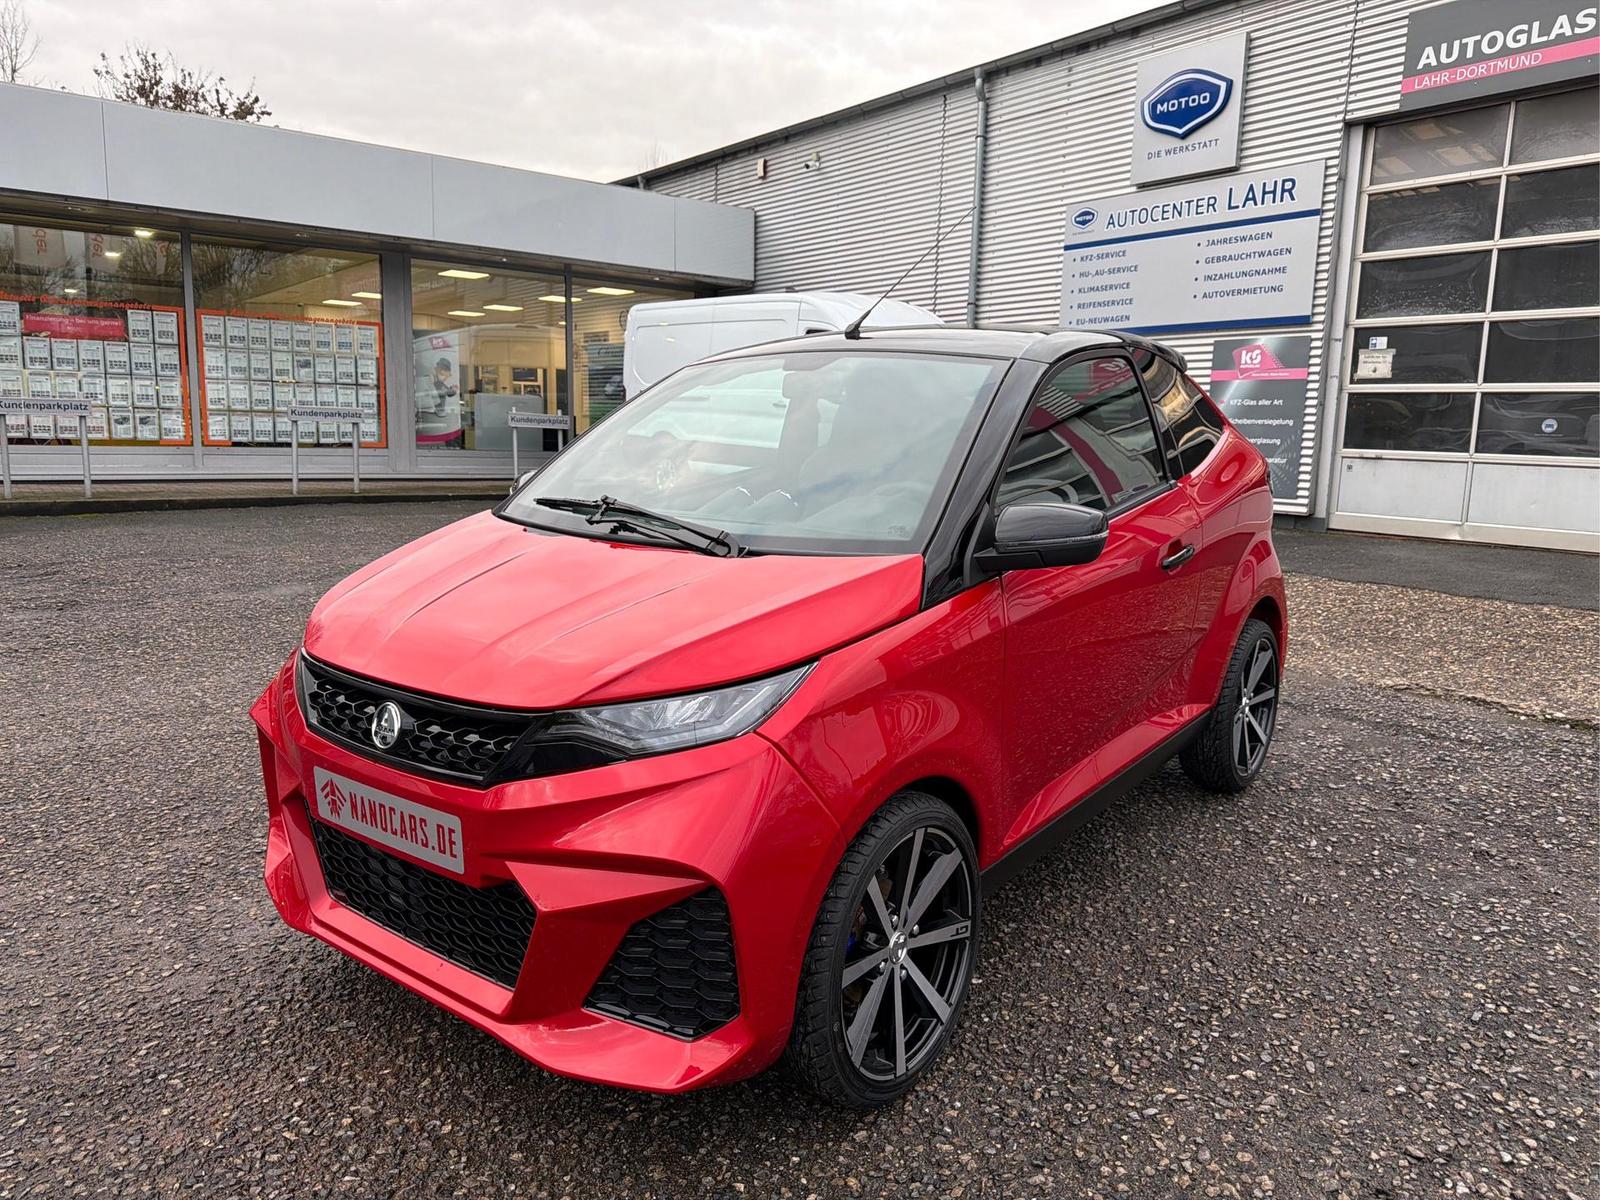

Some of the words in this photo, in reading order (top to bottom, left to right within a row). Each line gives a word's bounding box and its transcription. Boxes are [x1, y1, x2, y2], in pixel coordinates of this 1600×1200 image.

[1416, 8, 1597, 69] AUTOGLAS
[1414, 52, 1542, 90] LAHR-DORTMUND
[1156, 92, 1210, 115] MOTOO
[1147, 149, 1162, 160] DIE
[1165, 138, 1220, 156] WERKSTATT
[1105, 196, 1218, 230] AUTOCENTER
[1227, 177, 1297, 211] LAHR
[1206, 231, 1273, 247] JAHRESWAGEN
[1080, 250, 1127, 262] KFZ-SERVICE
[1204, 247, 1292, 264] GEBRAUCHTWAGEN
[1203, 266, 1287, 282] INZAHLUNGNAHME
[1078, 282, 1131, 294] KLIMASERVICE
[1202, 284, 1284, 299] AUTOVERMIETUNG
[1077, 298, 1134, 310] REIFENSERVICE
[1076, 315, 1131, 326] EU-NEUWAGEN
[290, 408, 362, 419] Kundenparkplatz
[510, 415, 569, 426] Kundenparkplatz
[349, 791, 458, 859] NANOCARS.DE
